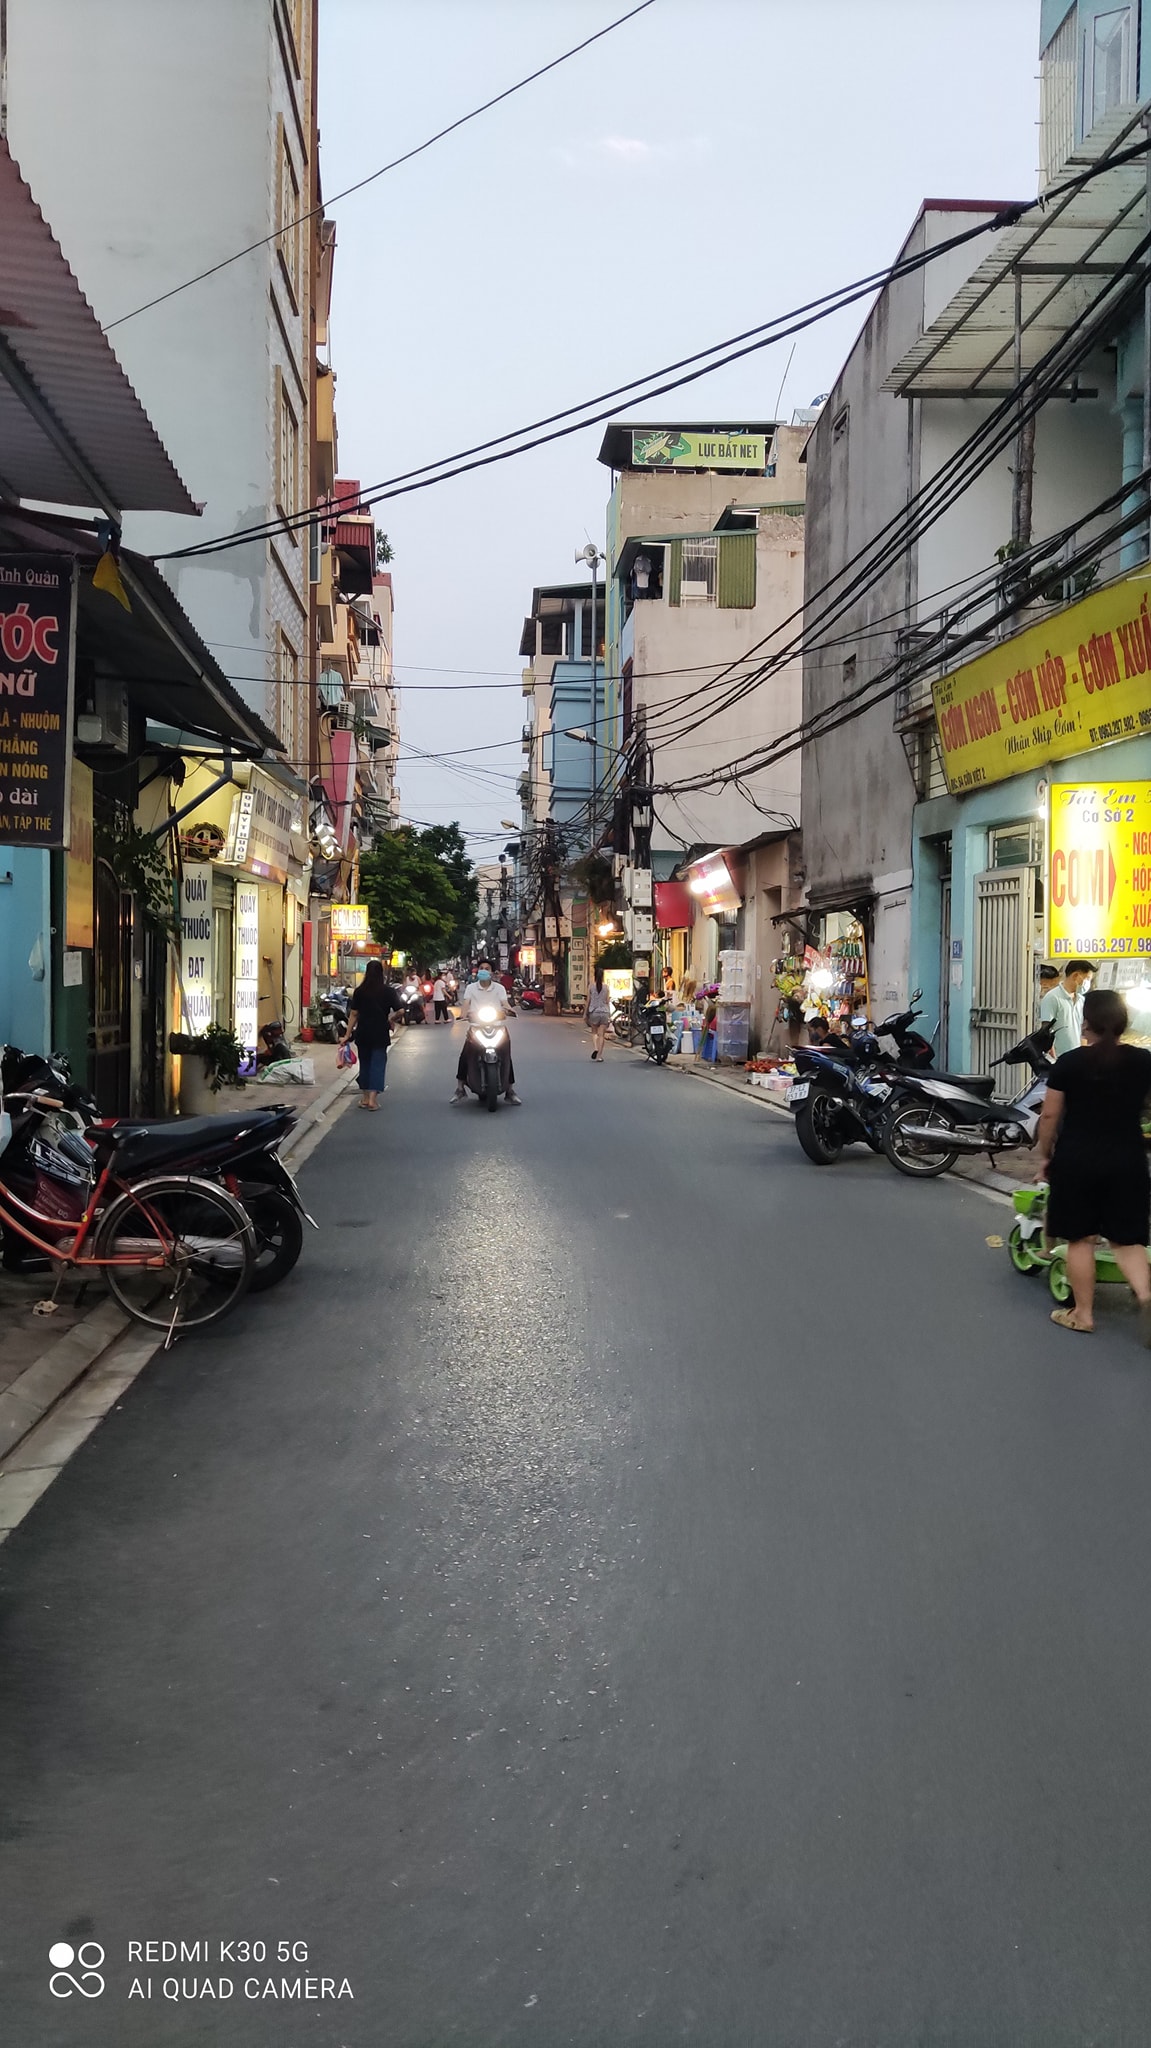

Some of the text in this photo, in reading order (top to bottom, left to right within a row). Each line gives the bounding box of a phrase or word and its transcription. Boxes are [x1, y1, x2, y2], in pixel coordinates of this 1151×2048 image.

[698, 441, 757, 459] LỤC BÁT NET
[0, 603, 59, 664] ÓC
[1006, 669, 1040, 724] CƠM
[1078, 632, 1120, 695] CƠM
[1032, 725, 1052, 745] Ship
[12, 761, 48, 779] NÓNG
[9, 788, 38, 805] dài
[1103, 788, 1138, 805] Em
[1104, 807, 1122, 822] Sở
[1126, 809, 1134, 822] 2
[183, 910, 211, 940] THUỐC
[1054, 938, 1072, 953] ĐT:
[240, 1021, 252, 1040] GPP
